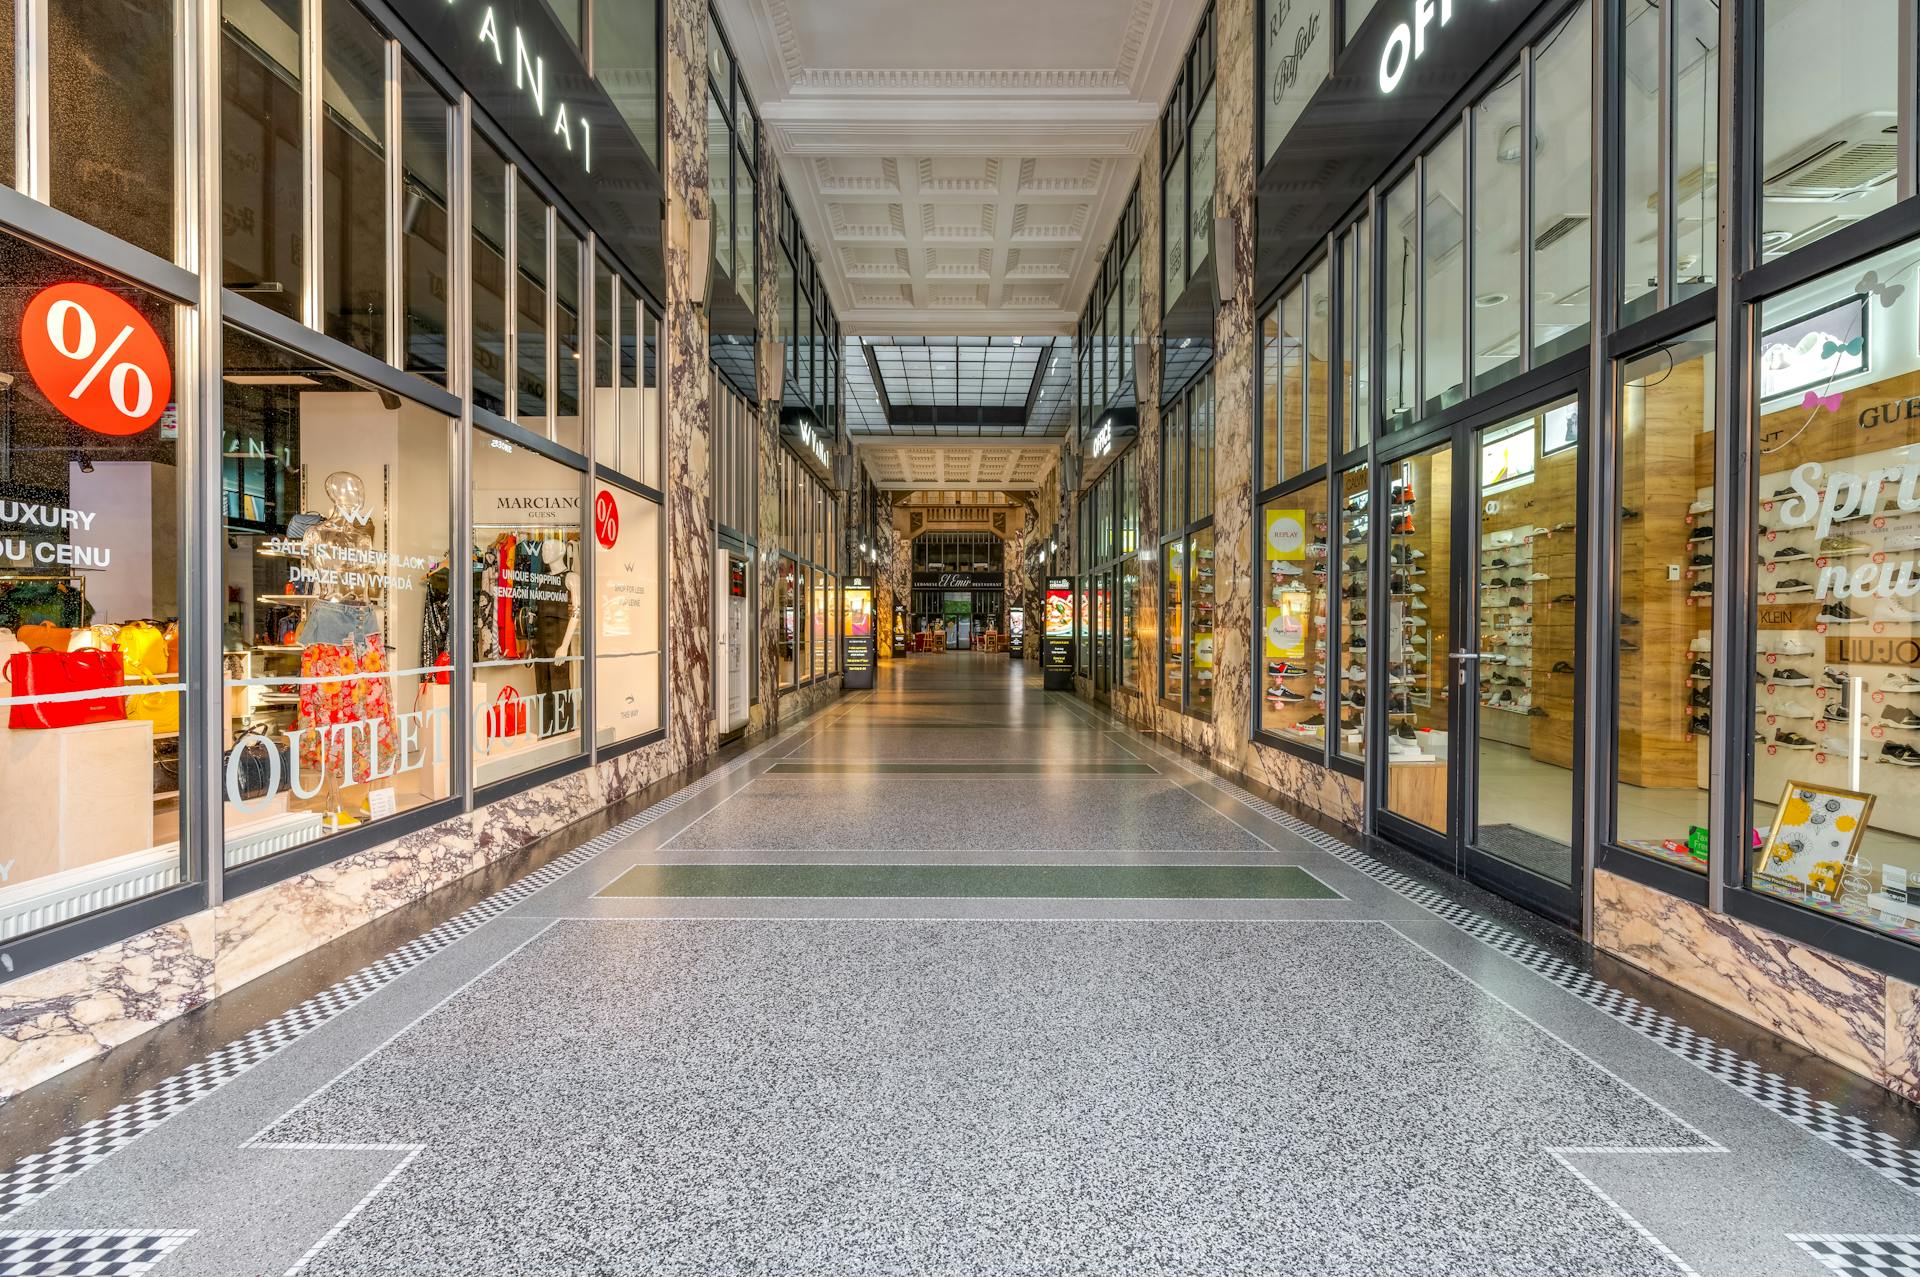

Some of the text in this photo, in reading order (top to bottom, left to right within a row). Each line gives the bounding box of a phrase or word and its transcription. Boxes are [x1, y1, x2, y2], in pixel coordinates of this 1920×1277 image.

[1273, 9, 1321, 106] Buffalo
[1093, 418, 1111, 458] OFFICE
[35, 542, 111, 567] CENU
[270, 536, 310, 557] SALE
[314, 544, 330, 559] IS
[332, 546, 358, 562] THE
[358, 549, 386, 566] NEW
[341, 573, 367, 586] JEN
[369, 574, 413, 590] VYPADÁ
[502, 569, 562, 586] UNIQUE SHOPPING
[949, 573, 972, 588] Emir
[1760, 611, 1792, 624] KLEIN
[473, 688, 583, 757] OUTLET
[226, 707, 450, 815] OUTLET
